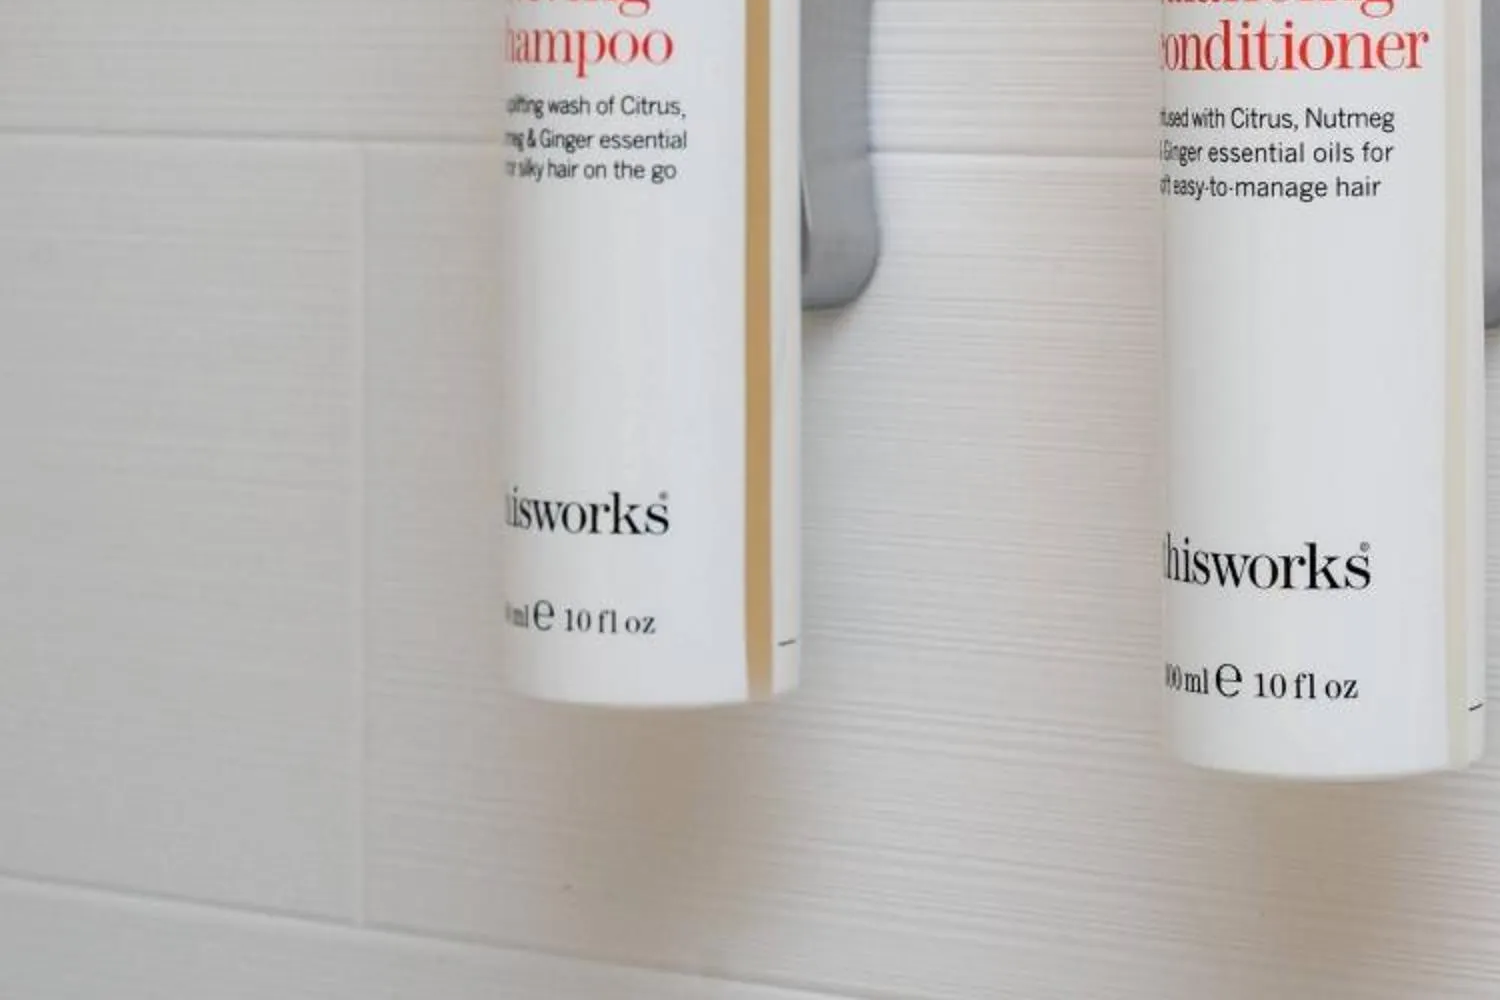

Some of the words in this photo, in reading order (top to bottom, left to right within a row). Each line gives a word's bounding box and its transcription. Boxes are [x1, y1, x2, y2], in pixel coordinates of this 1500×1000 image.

[548, 95, 591, 115] wash
[596, 96, 615, 115] of
[620, 96, 687, 119] Citrus,
[1192, 107, 1225, 128] with
[1231, 107, 1298, 132] Citrus,
[1306, 107, 1395, 133] Nutmeg
[539, 128, 592, 153] Ginger
[599, 130, 687, 149] essential
[1208, 142, 1305, 163] essential
[1313, 142, 1355, 163] oils
[1362, 142, 1394, 163] for
[547, 158, 577, 178] hair
[583, 165, 606, 178] on
[613, 161, 645, 179] the
[651, 165, 677, 184] go
[1336, 176, 1381, 197] hair
[564, 609, 591, 632] 10
[599, 609, 617, 634] fl
[625, 616, 656, 635] oz
[1254, 673, 1286, 699] 10
[1295, 673, 1316, 699] fl
[1325, 679, 1358, 699] oz
